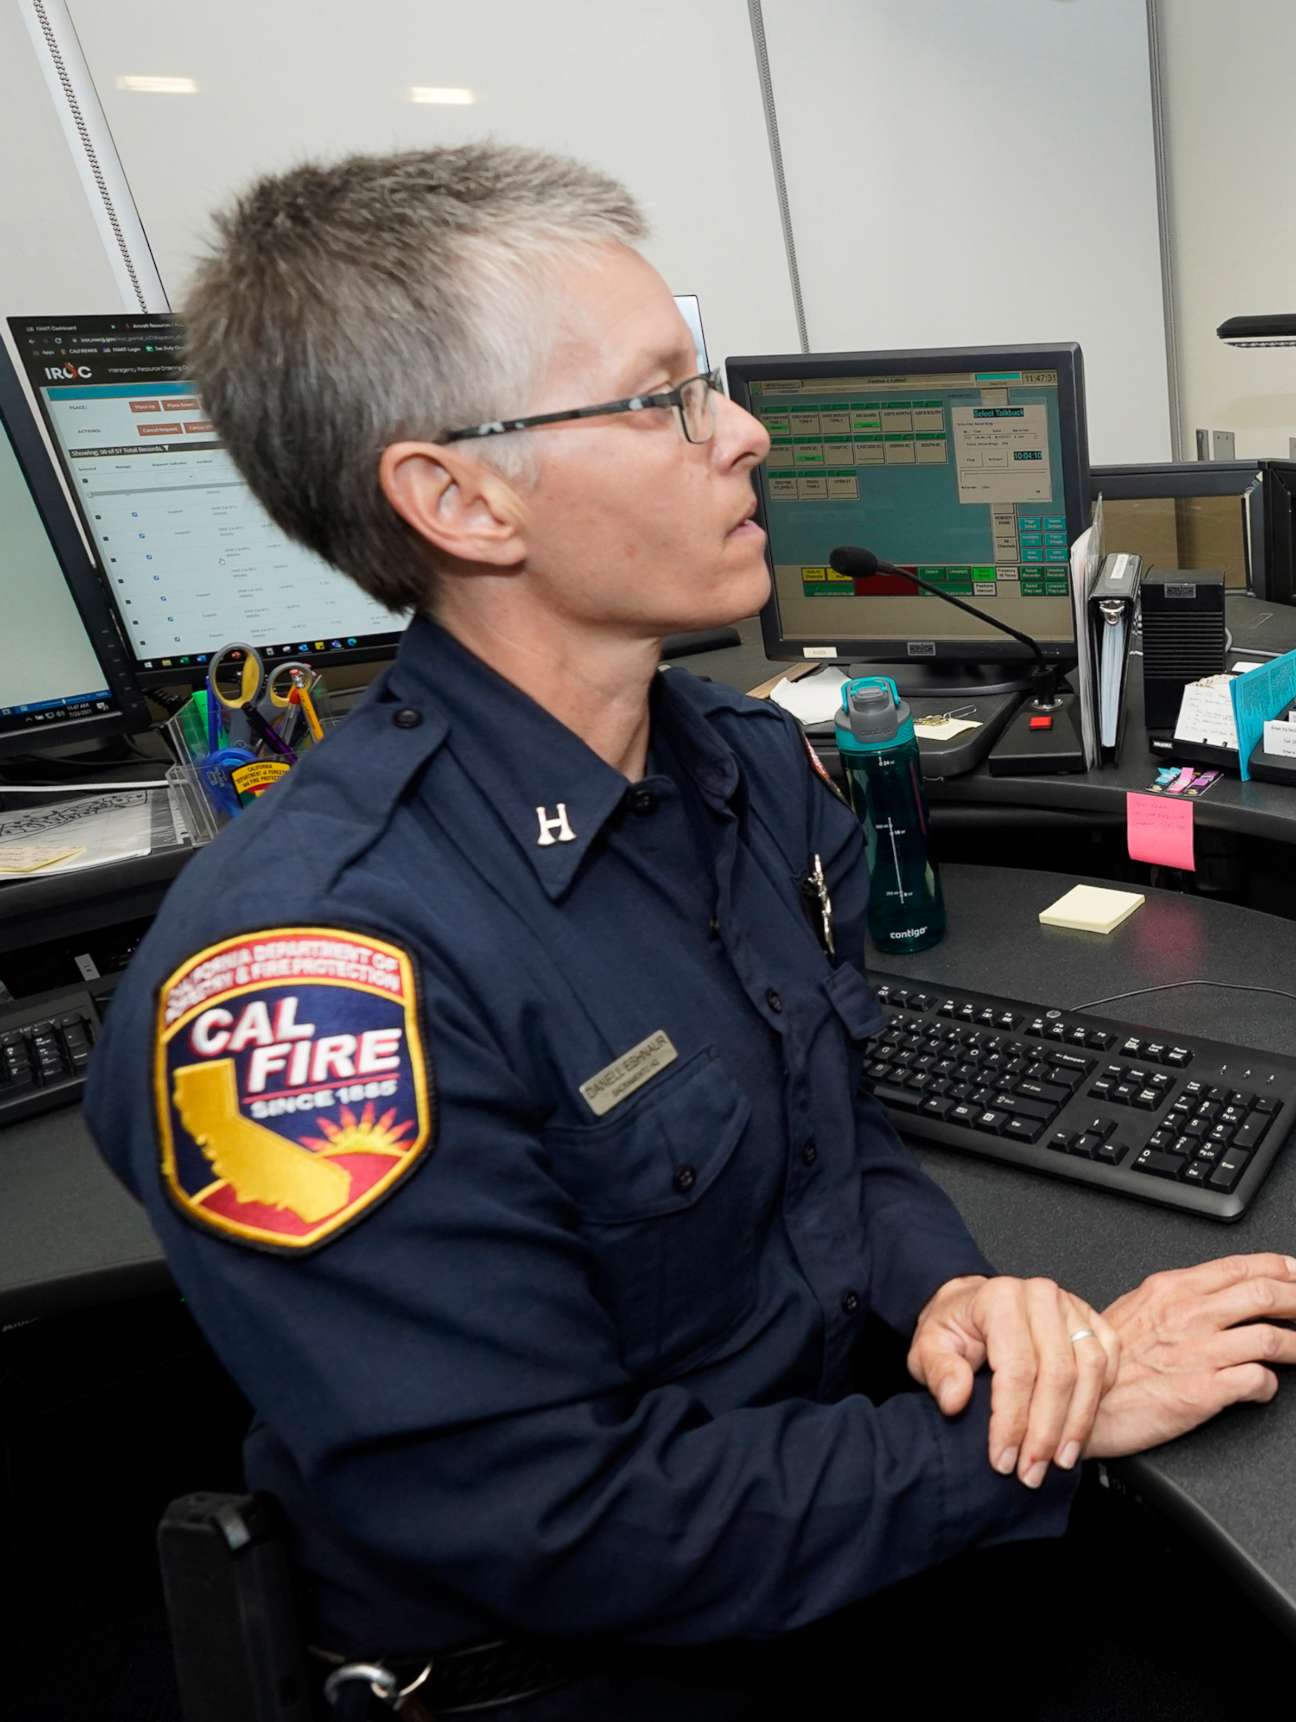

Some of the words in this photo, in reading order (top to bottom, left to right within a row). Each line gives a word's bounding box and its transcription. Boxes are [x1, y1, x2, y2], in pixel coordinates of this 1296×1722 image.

[536, 802, 577, 846] H
[889, 927, 927, 940] contigo
[253, 940, 376, 964] DEPARTMENT
[372, 952, 401, 971] OF
[235, 966, 250, 985] &
[250, 959, 286, 980] FIRE
[290, 956, 402, 993] PROTECTION
[191, 995, 316, 1056] CAL
[246, 1027, 403, 1094] FIRE
[250, 1088, 335, 1119] SINCE
